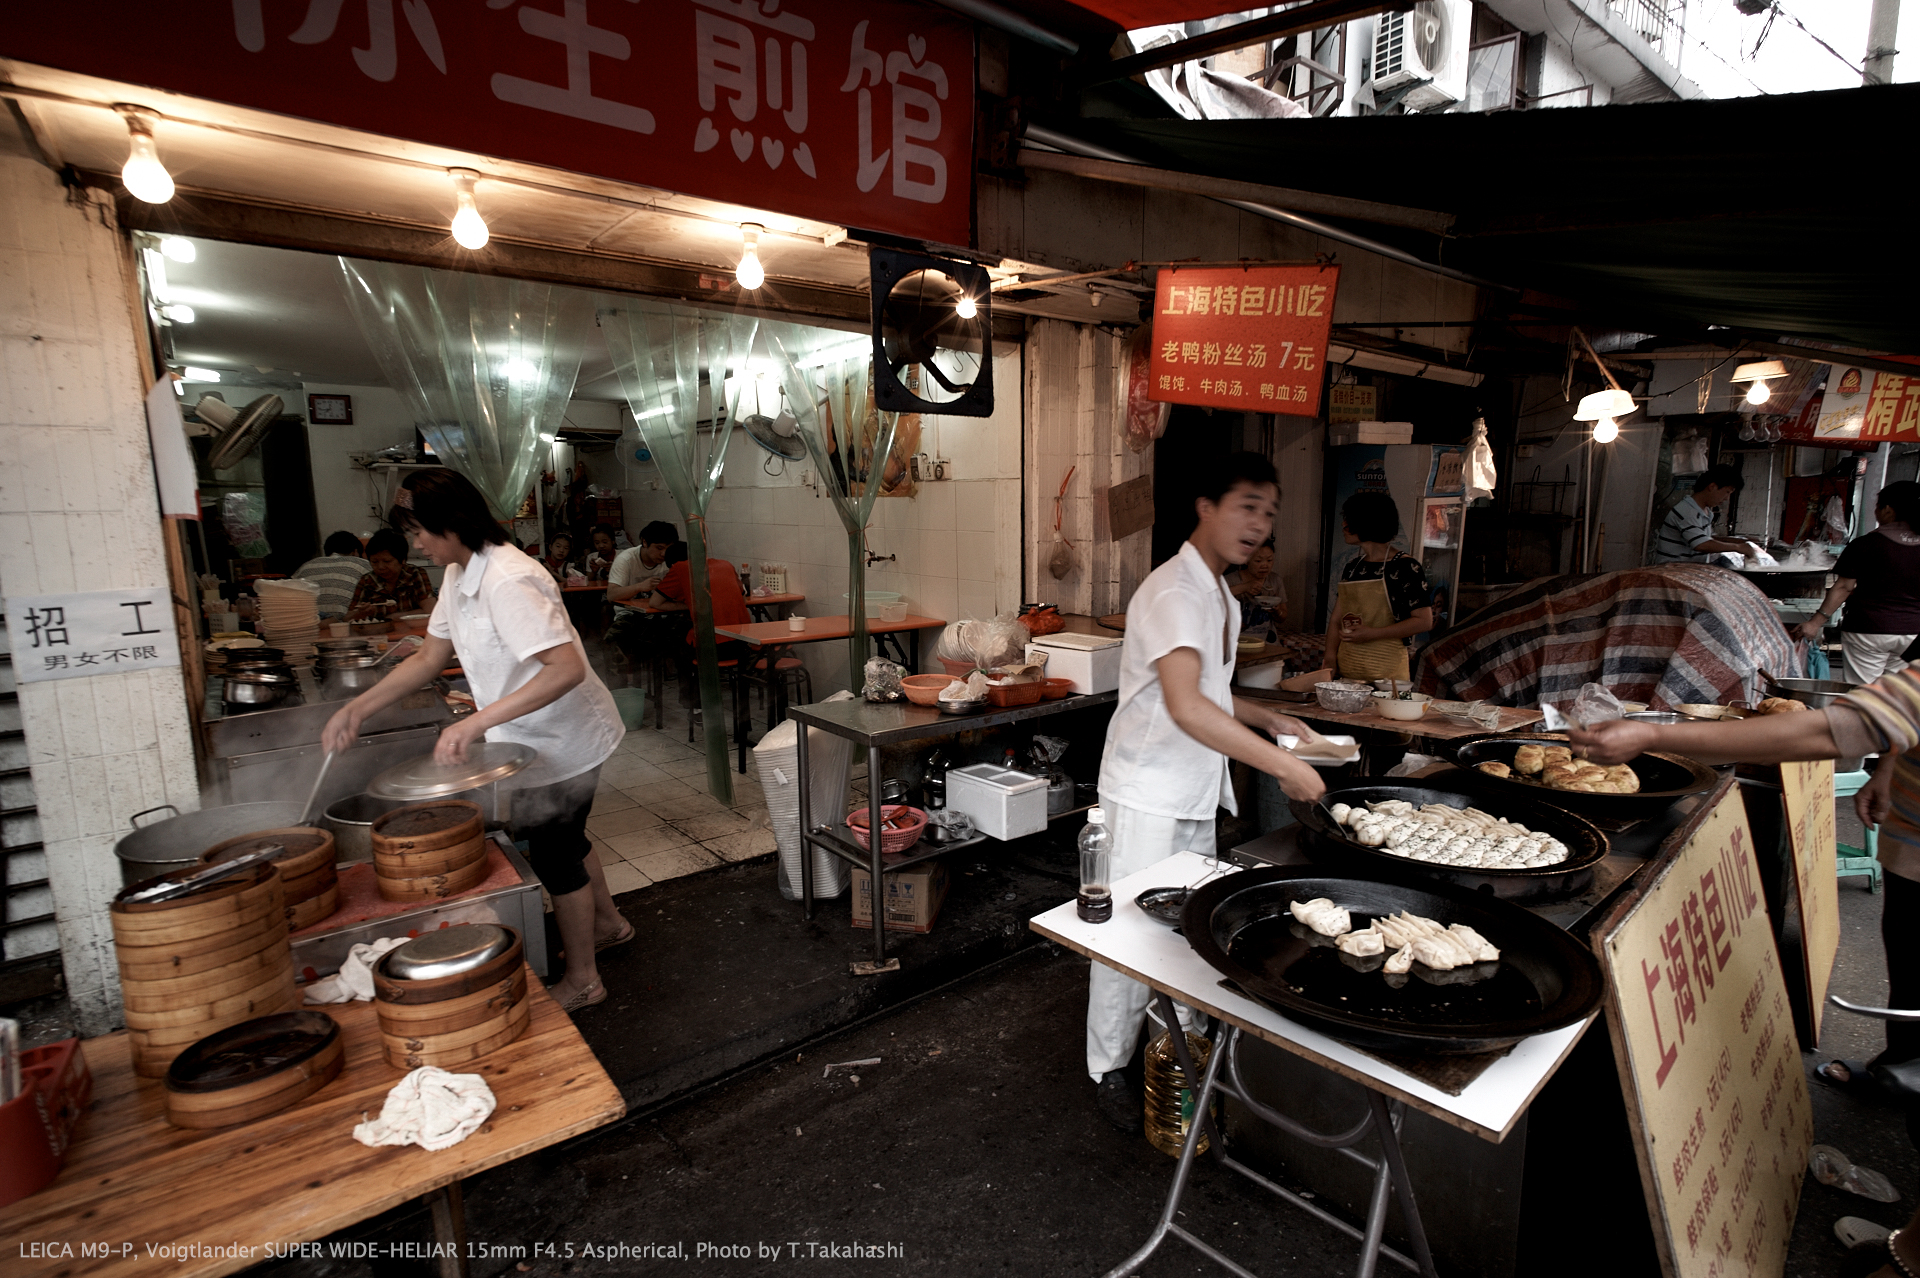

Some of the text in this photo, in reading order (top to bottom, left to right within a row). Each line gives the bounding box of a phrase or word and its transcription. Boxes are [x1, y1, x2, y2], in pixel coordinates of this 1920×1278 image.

[1161, 284, 1327, 317] 上海特色小吃
[1161, 340, 1316, 371] 老鸭粉丝汤 7元
[1259, 383, 1308, 403] 鸭血汤
[43, 645, 159, 671] 男女不限
[1641, 825, 1758, 1090] 上海特色小吃
[1672, 1106, 1707, 1196] 鲜肉生煎
[1686, 1163, 1720, 1259] 鲜肉锅贴
